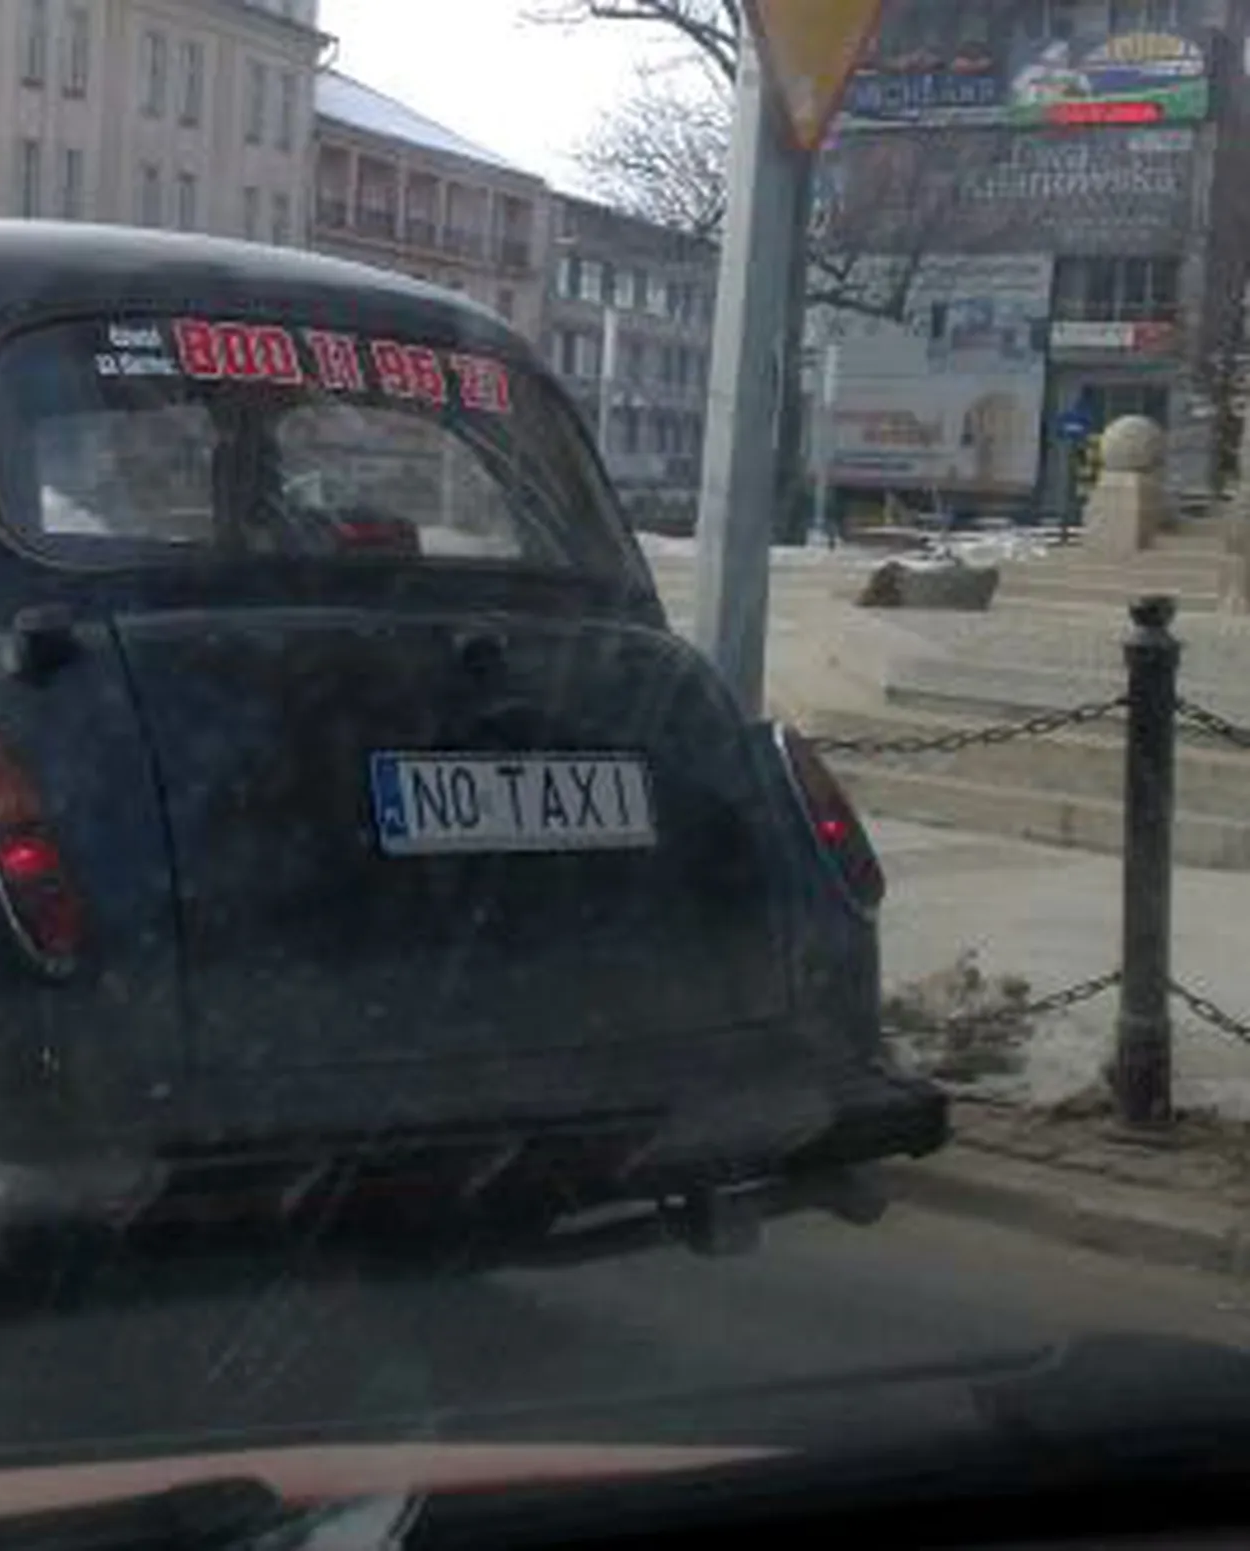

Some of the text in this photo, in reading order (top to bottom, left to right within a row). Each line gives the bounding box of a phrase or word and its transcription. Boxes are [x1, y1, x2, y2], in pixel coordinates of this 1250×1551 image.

[172, 317, 303, 384] 800
[412, 765, 631, 830] NO TAXI
